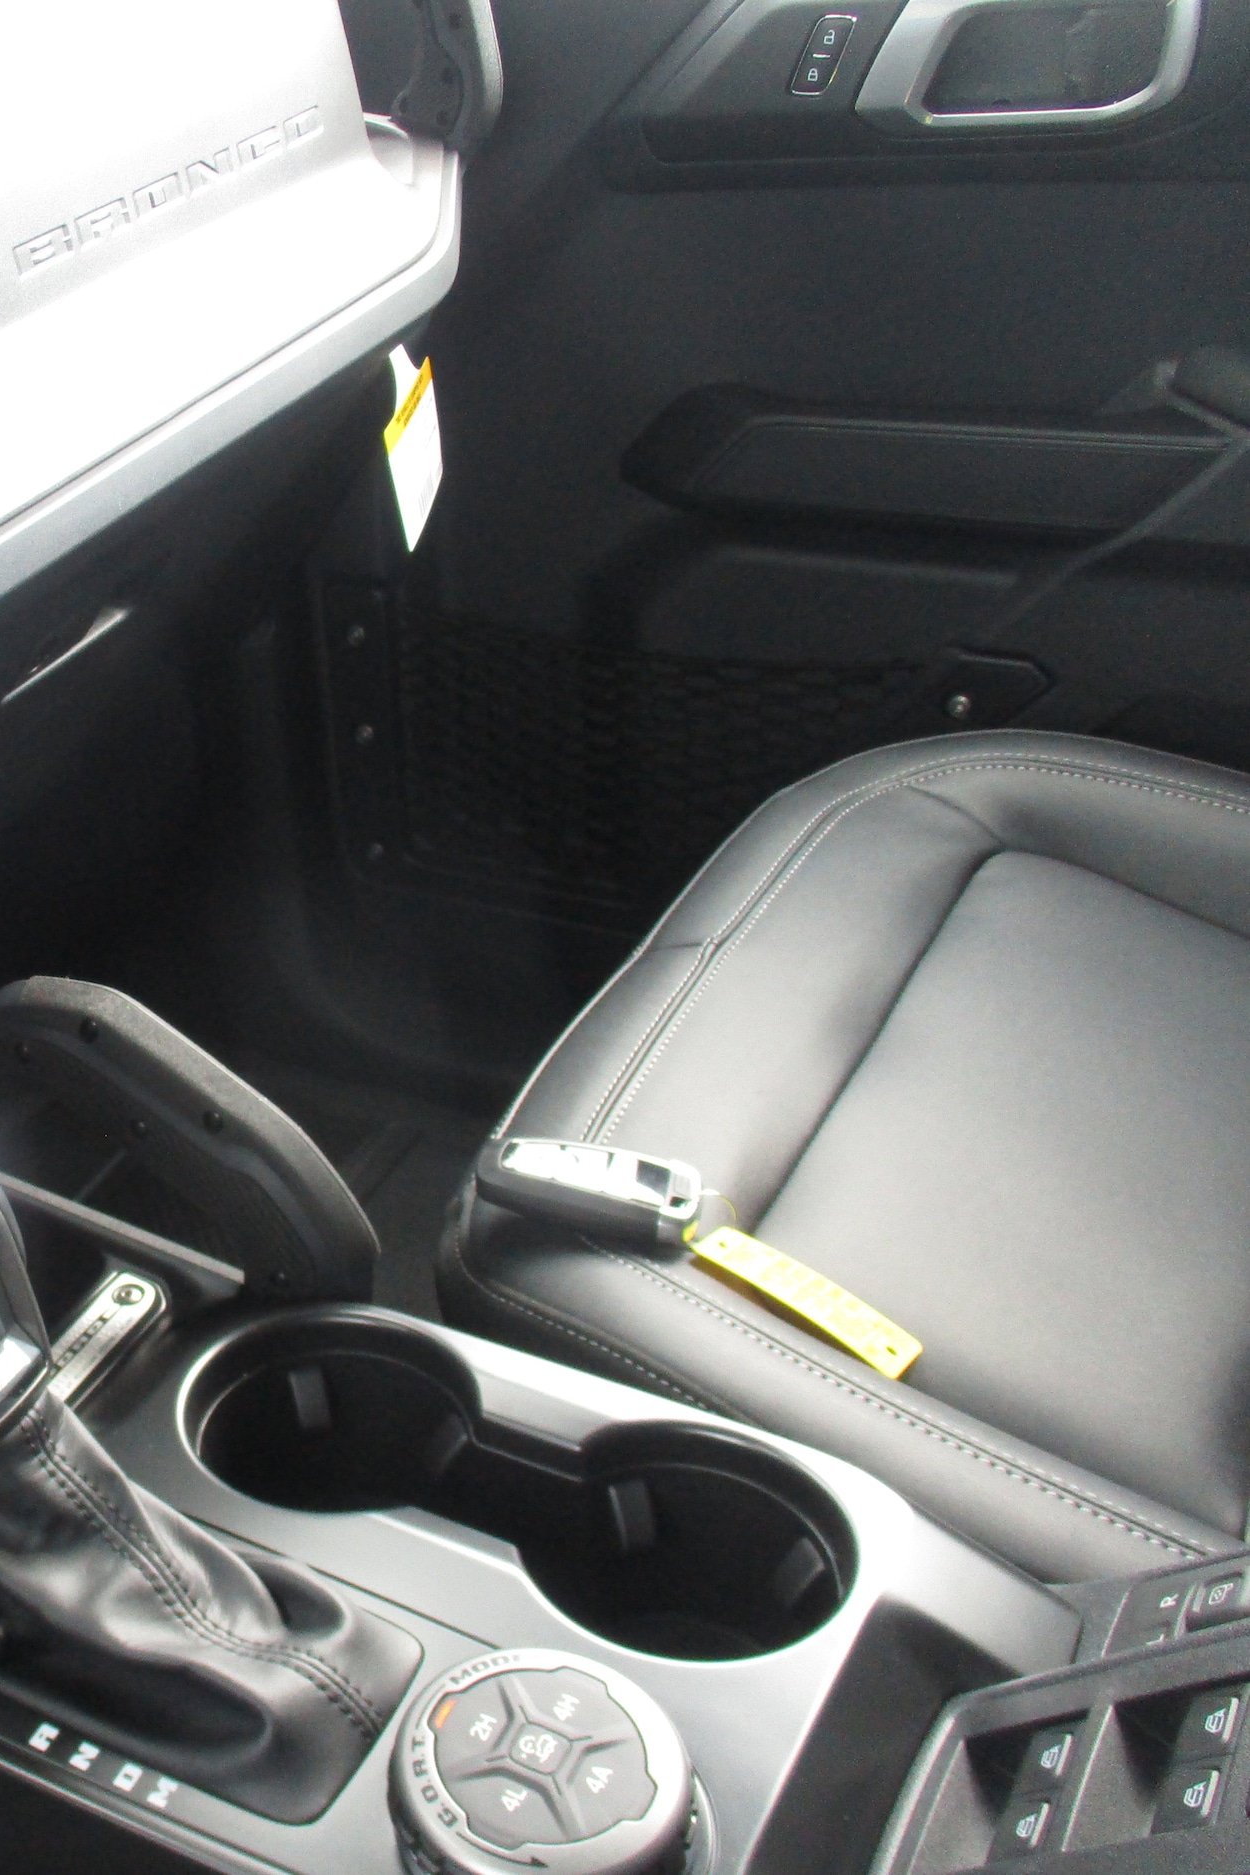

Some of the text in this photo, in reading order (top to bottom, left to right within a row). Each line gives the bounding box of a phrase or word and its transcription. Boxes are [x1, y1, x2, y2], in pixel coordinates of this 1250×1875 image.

[12, 104, 325, 278] BRONCO
[552, 1692, 581, 1722] 4H
[469, 1712, 498, 1742] 2H
[27, 1720, 60, 1753] R
[68, 1741, 101, 1772] N
[112, 1761, 144, 1792] D
[584, 1765, 615, 1795] 4A
[500, 1786, 529, 1813] 4L
